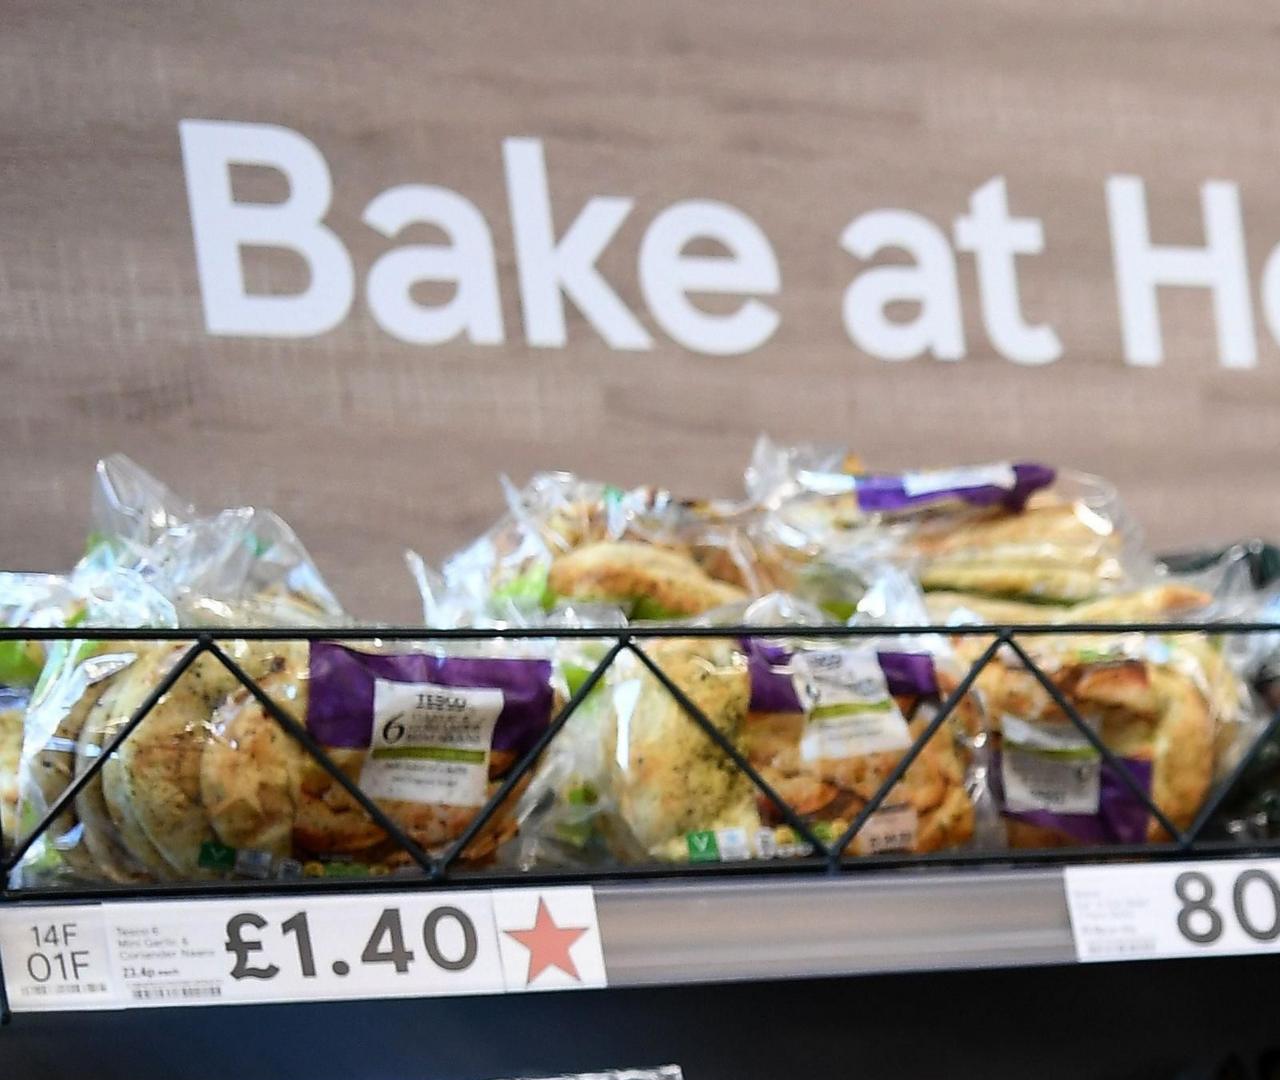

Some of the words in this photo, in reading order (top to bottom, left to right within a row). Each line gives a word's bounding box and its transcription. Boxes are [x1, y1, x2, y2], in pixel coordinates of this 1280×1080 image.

[179, 118, 782, 355] Bake
[840, 176, 1064, 366] at
[382, 710, 405, 744] 6
[31, 923, 77, 947] 14F
[225, 906, 479, 980] £1.40
[27, 950, 89, 983] 01F
